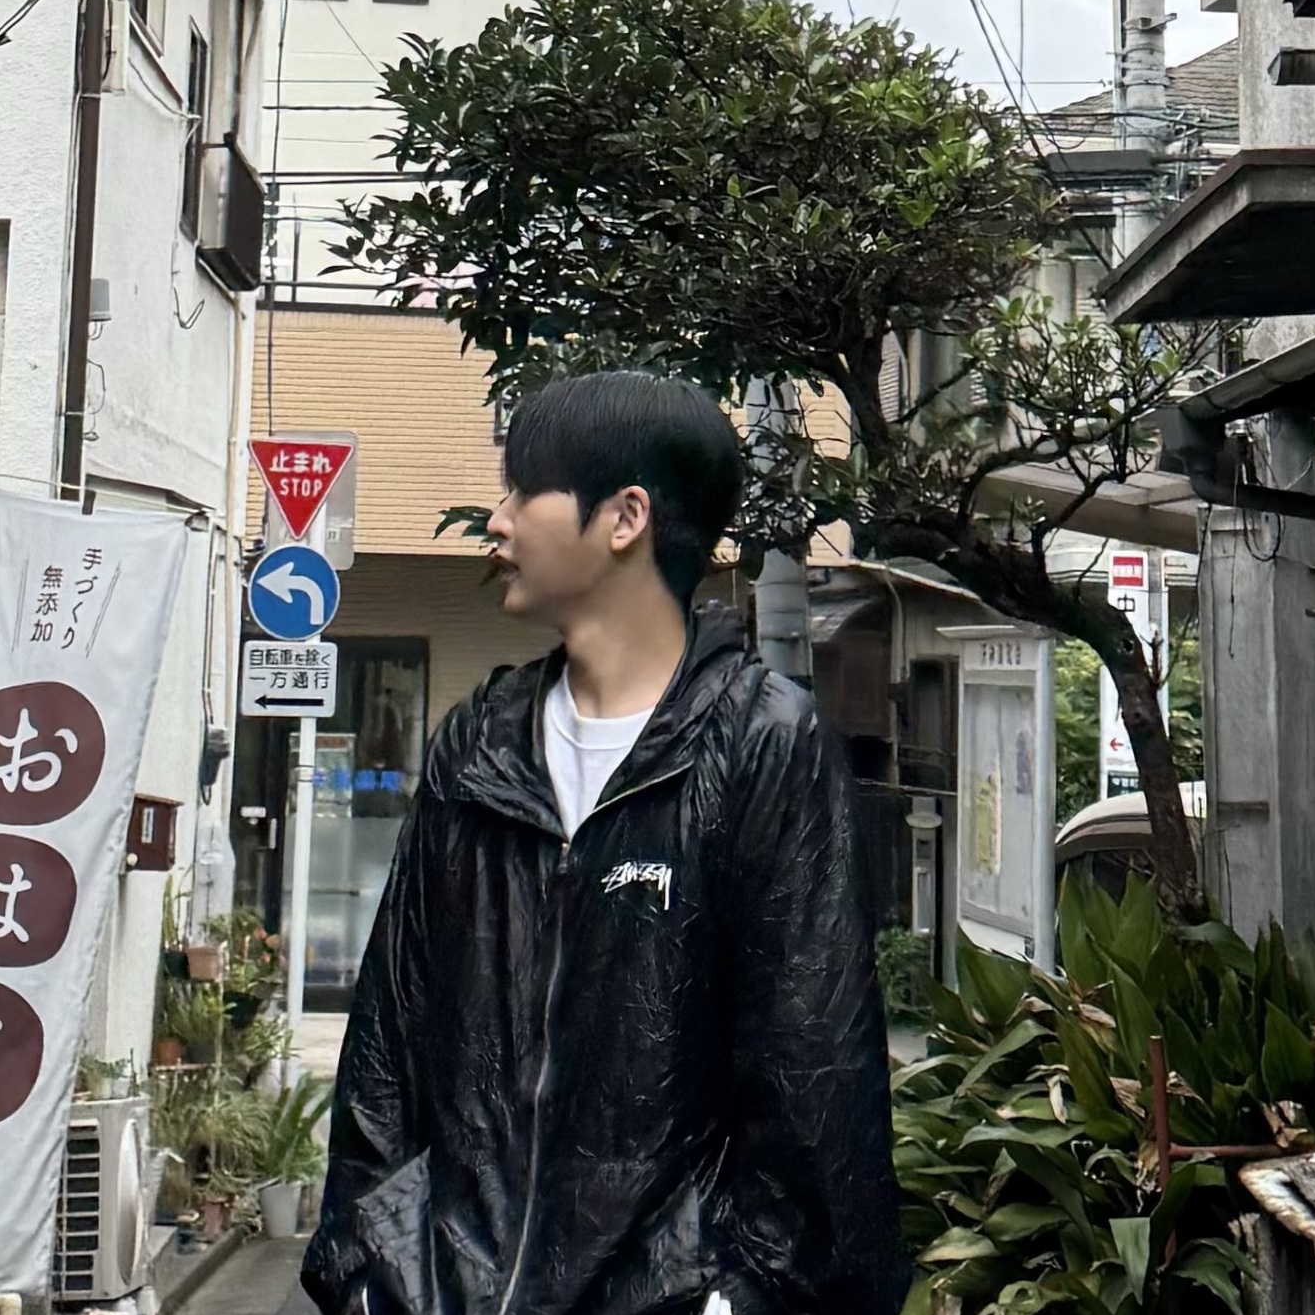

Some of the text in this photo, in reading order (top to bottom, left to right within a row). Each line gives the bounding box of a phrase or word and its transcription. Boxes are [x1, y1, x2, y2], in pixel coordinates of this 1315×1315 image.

[269, 449, 332, 473] 止まれ
[280, 477, 323, 497] STOP
[30, 565, 64, 642] 無添加
[61, 547, 103, 650] 手づくり
[249, 648, 331, 666] 自転車を除く
[249, 671, 330, 690] 一方通行
